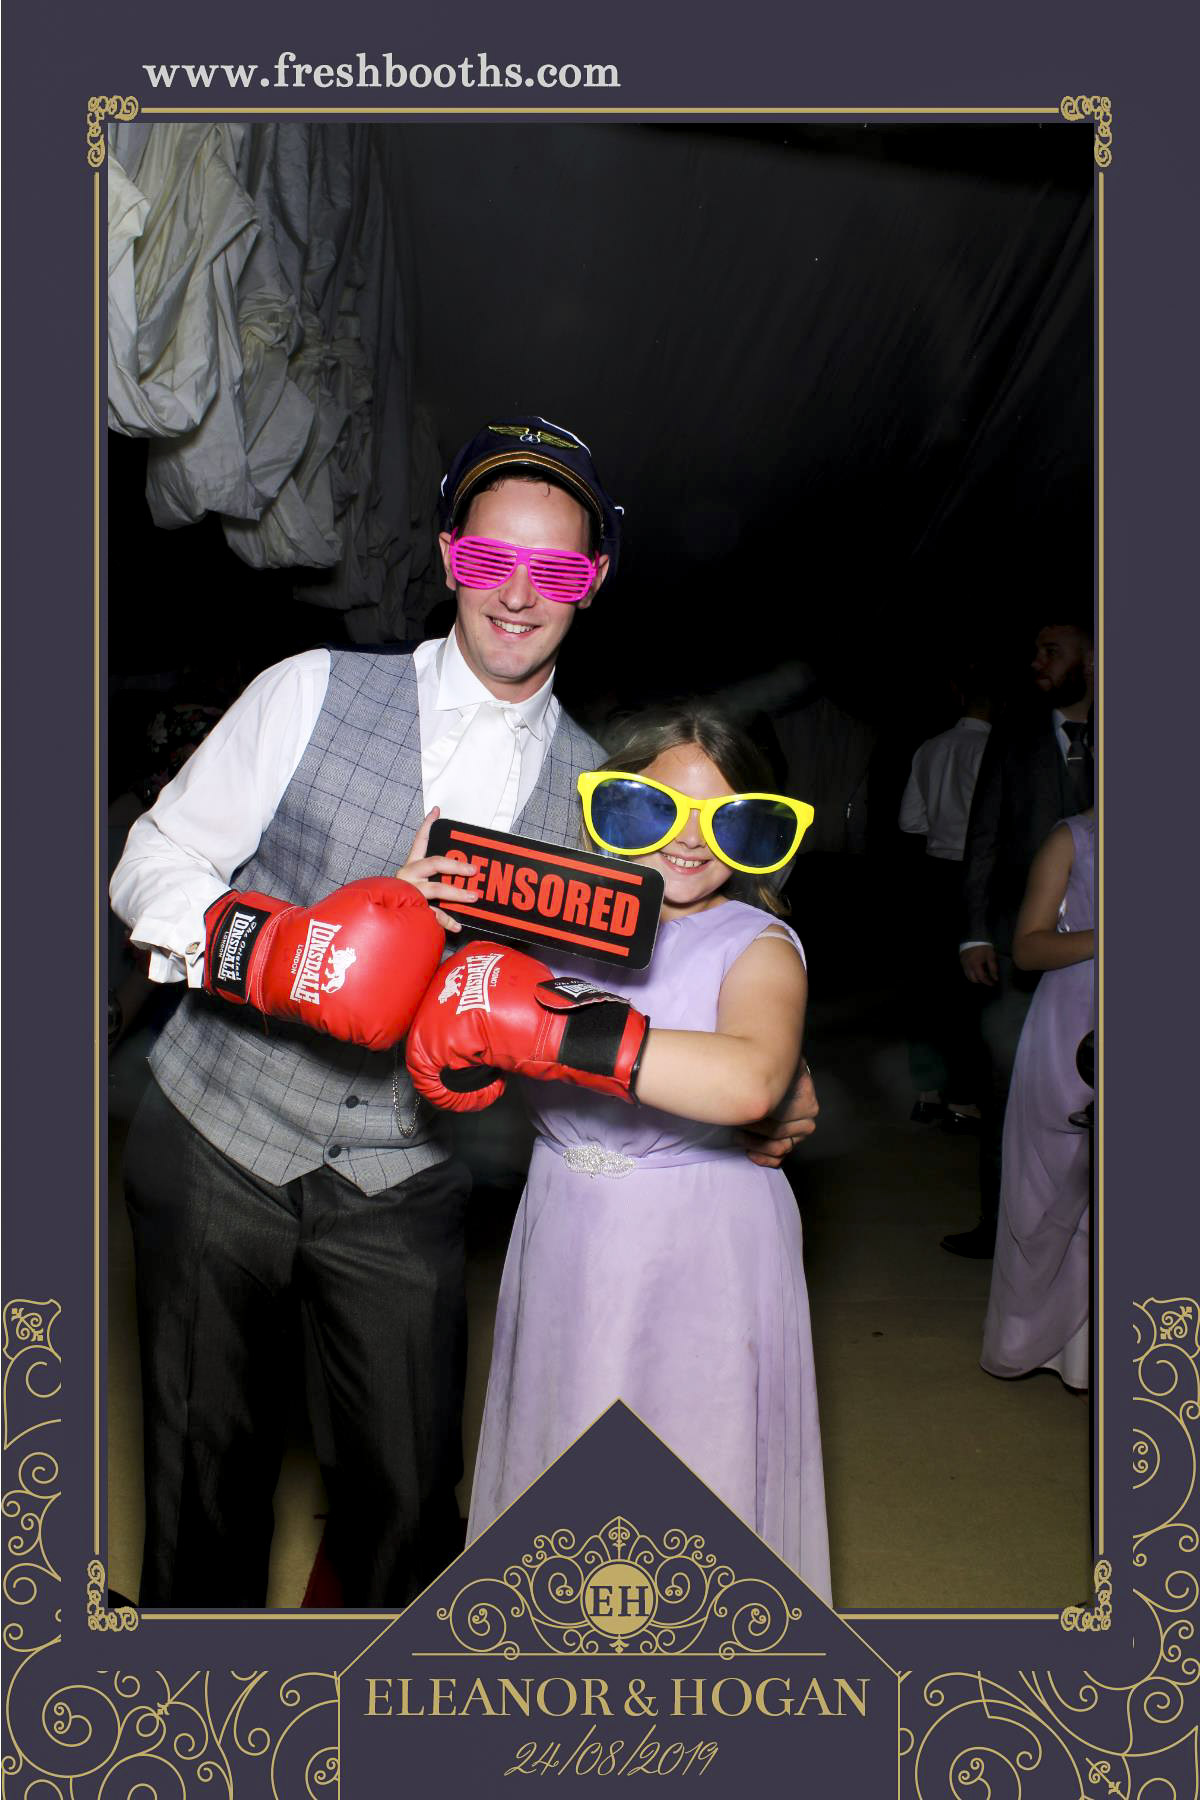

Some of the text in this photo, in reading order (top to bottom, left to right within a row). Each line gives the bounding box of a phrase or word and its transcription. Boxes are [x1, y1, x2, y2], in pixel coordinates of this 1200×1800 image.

[218, 931, 230, 958] LONDON
[218, 912, 256, 981] LONSDALE
[290, 944, 303, 974] LONDON
[290, 919, 342, 1005] LONSDALE
[456, 953, 504, 1015] LONSDALE
